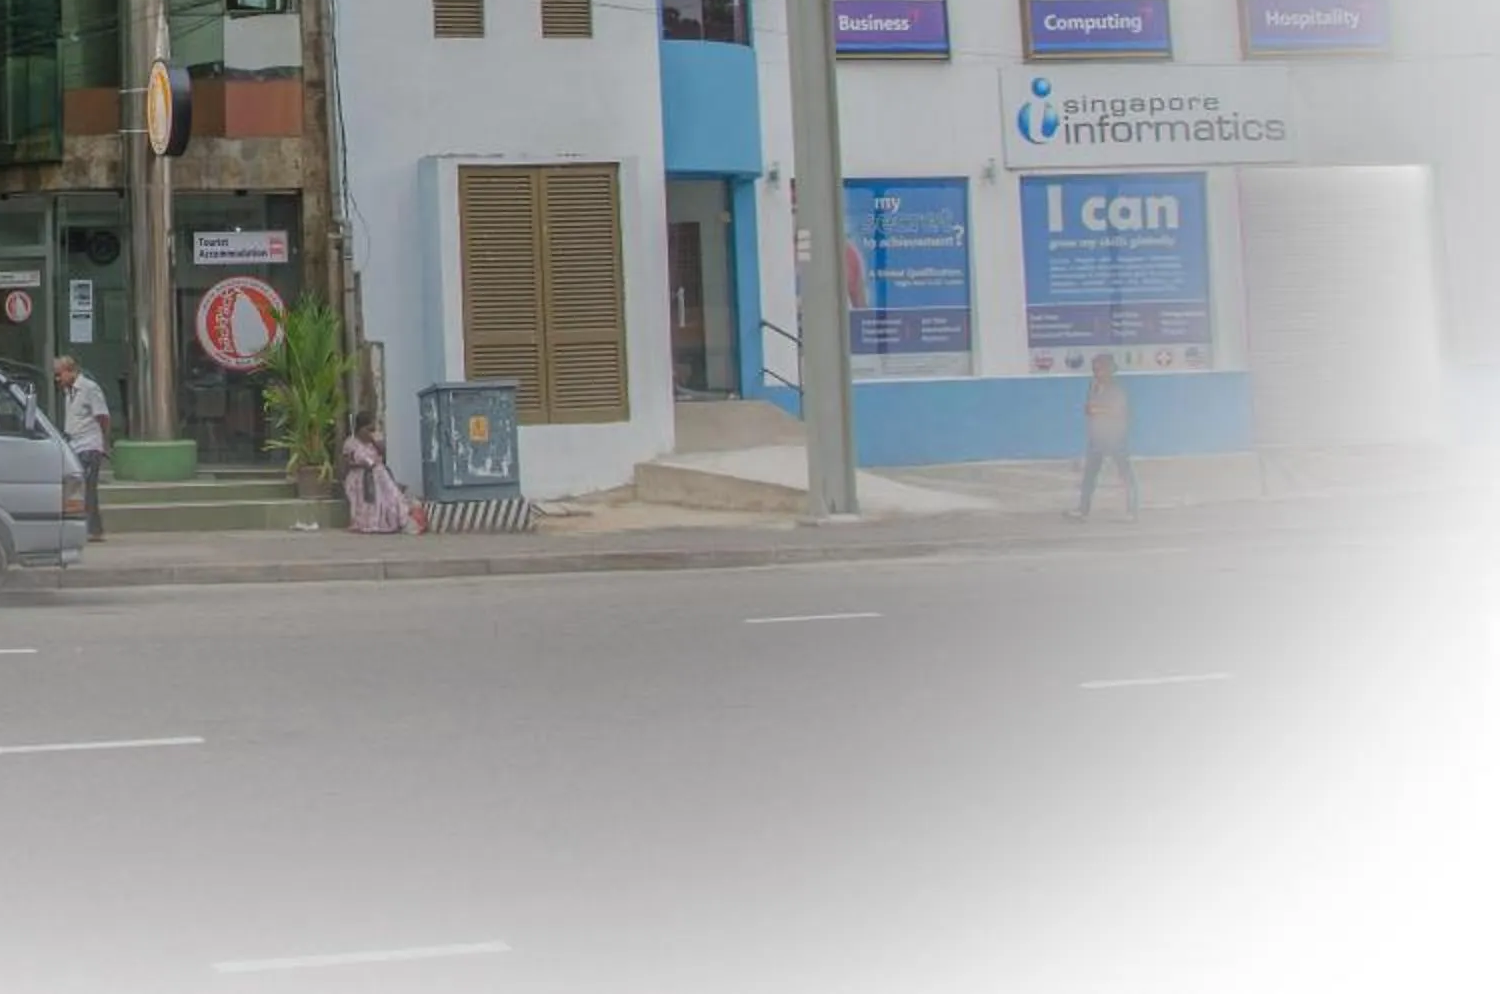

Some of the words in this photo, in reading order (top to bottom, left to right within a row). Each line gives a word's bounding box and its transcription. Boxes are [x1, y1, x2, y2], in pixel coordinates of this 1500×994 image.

[838, 14, 911, 32] Business
[1043, 14, 1143, 34] Computing
[1265, 9, 1360, 30] Hospitality
[1063, 95, 1220, 117] singapore
[1063, 112, 1286, 144] informatics
[874, 196, 900, 215] my
[1046, 184, 1064, 232] I
[1080, 193, 1181, 232] can
[197, 237, 229, 247] Tourist
